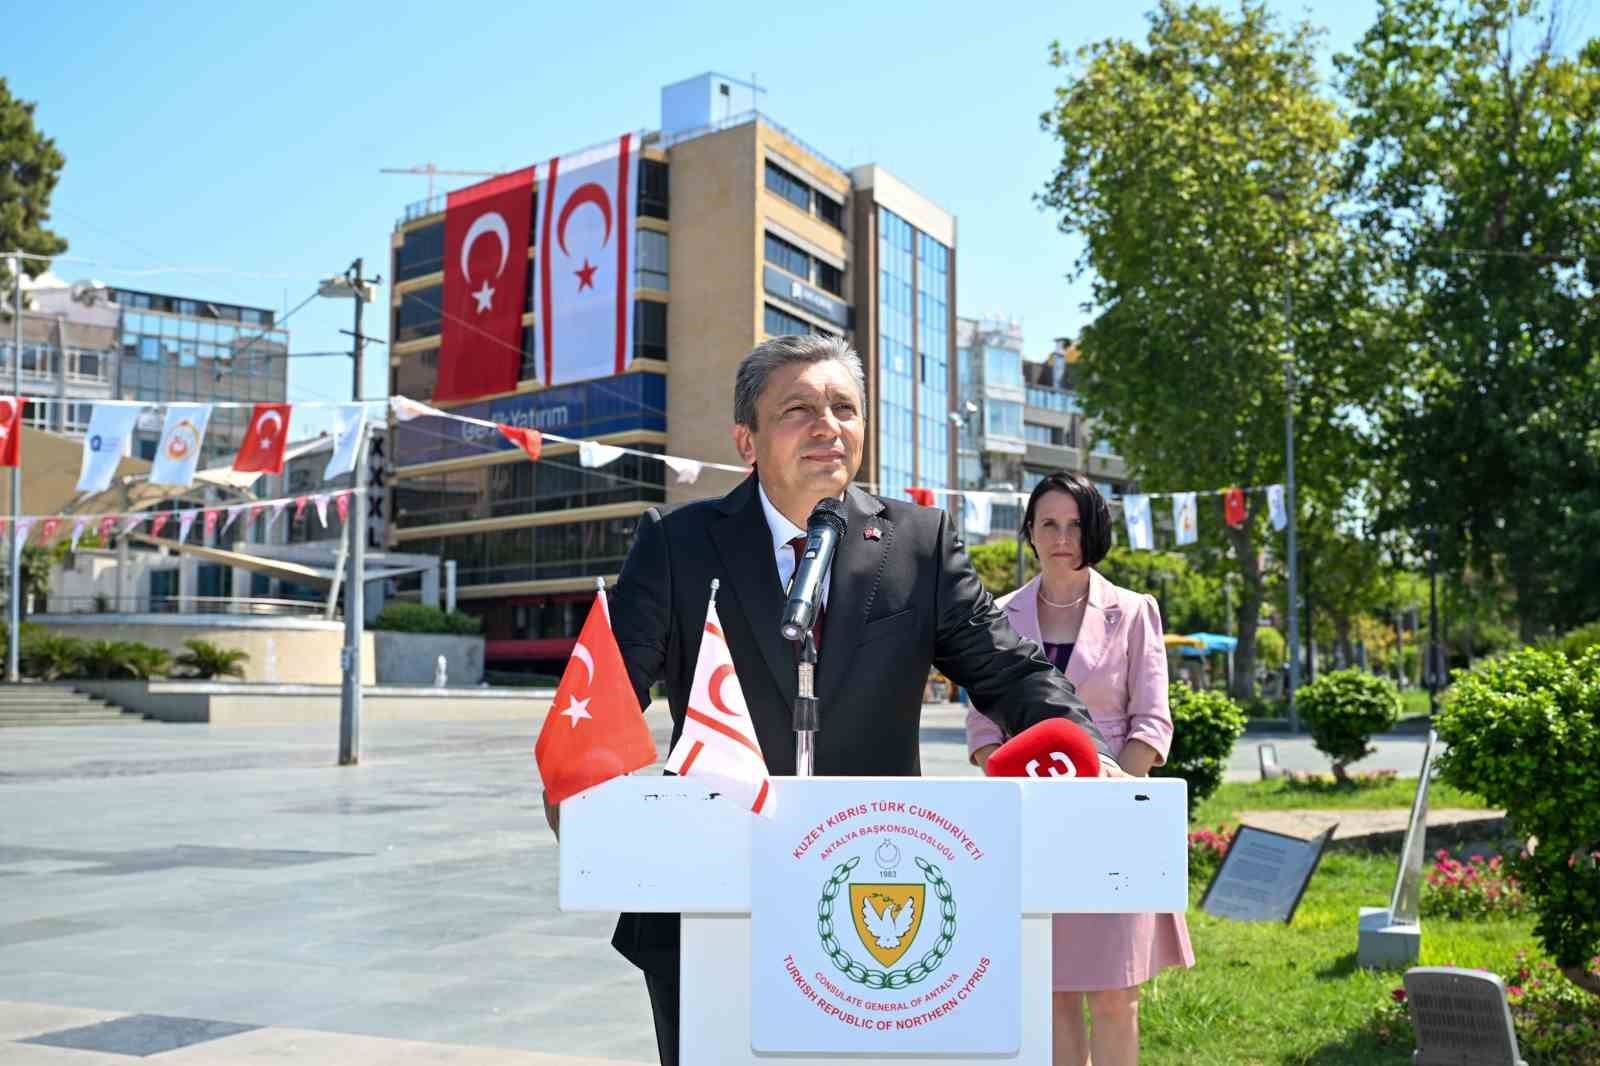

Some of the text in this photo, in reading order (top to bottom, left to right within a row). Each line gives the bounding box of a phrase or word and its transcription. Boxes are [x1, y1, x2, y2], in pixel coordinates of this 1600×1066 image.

[368, 436, 385, 548] XXXL
[793, 800, 984, 861] KUZEY KIBRIS TÜRK CUMHURİYETİ
[820, 823, 955, 862] ANTALYA BAŞKONSOLOSLUĞU
[879, 870, 897, 879] 1983
[784, 954, 991, 1031] TURKISH REPUBLIC OF NORTHERN CYPRUS
[815, 971, 960, 1012] CONSULATE GENERAL OF ANTALYA
